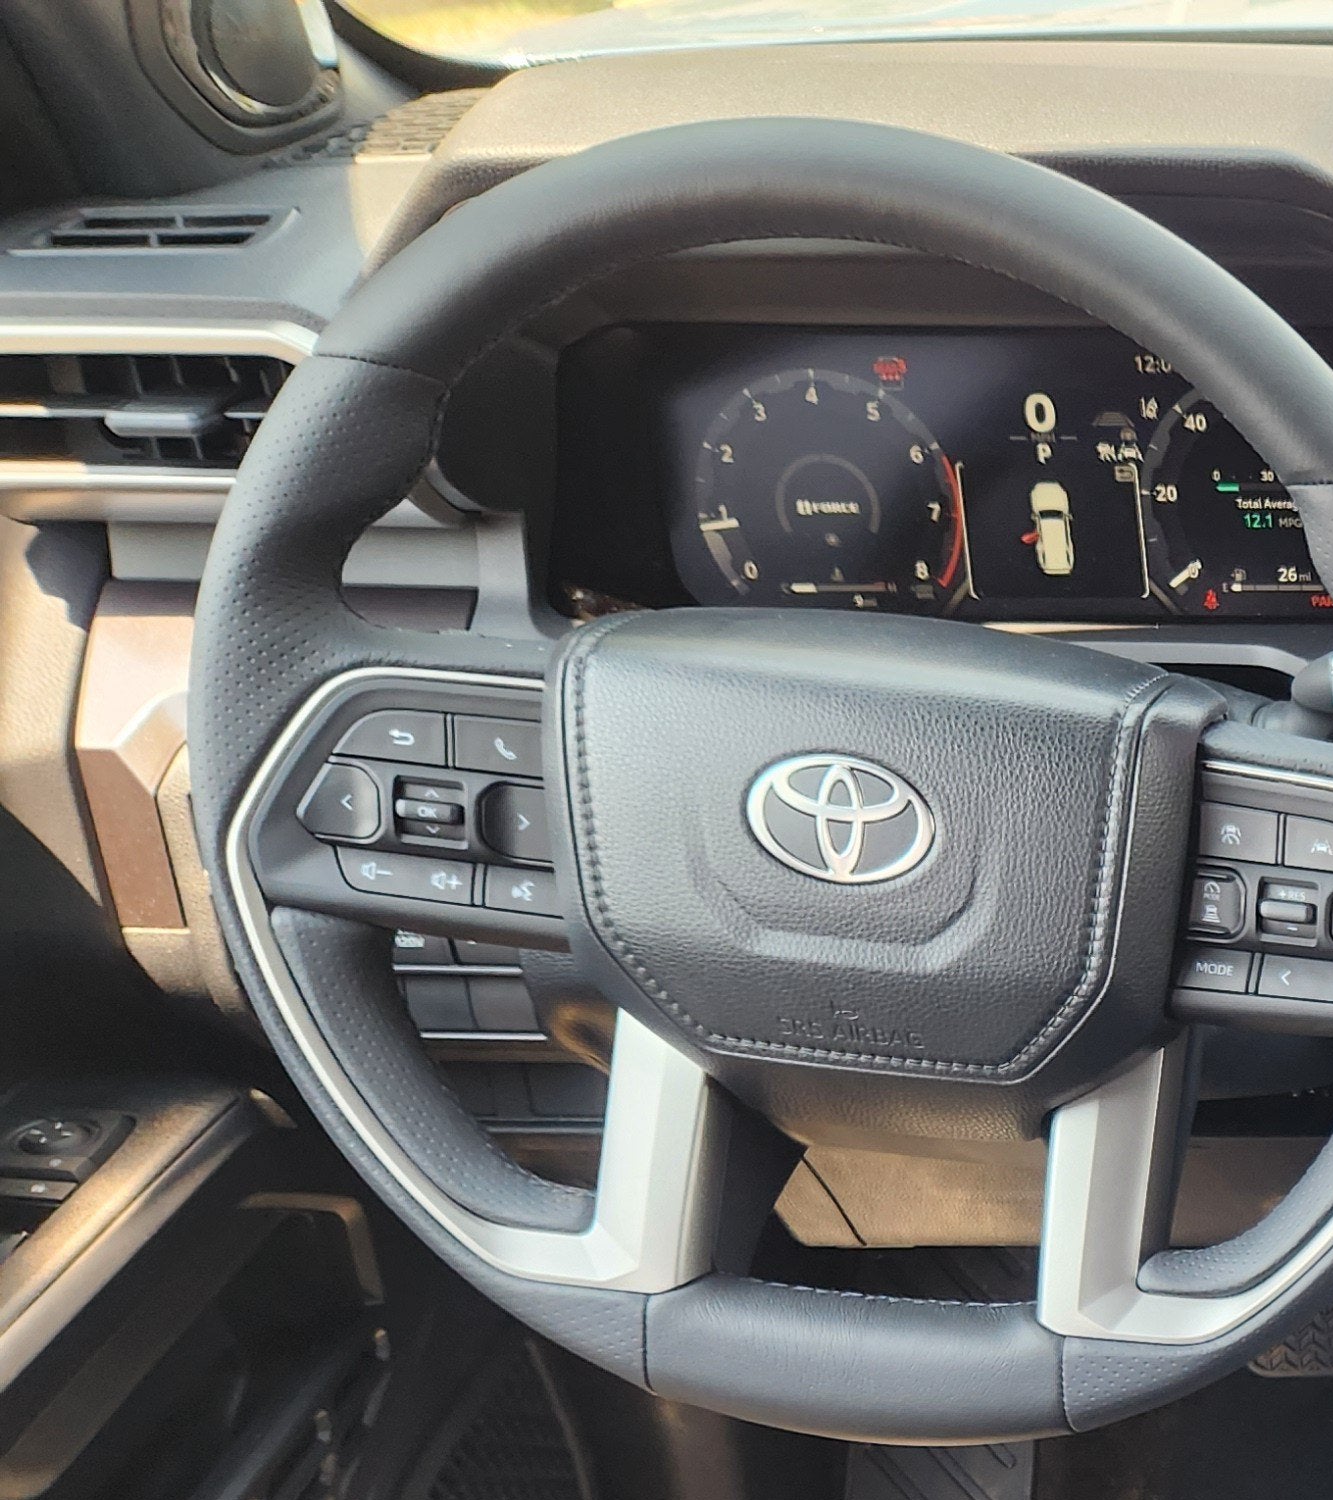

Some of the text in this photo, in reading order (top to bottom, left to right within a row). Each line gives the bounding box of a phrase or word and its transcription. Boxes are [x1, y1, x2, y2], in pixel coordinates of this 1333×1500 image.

[752, 402, 768, 422] 3
[866, 401, 881, 423] 5
[1025, 392, 1057, 433] 0
[1183, 412, 1208, 433] 40
[719, 443, 735, 463] 2
[909, 444, 924, 464] 6
[1036, 441, 1052, 465] P
[1211, 468, 1275, 483] 0 30
[1154, 484, 1178, 503] 20
[927, 501, 942, 523] 7
[1236, 498, 1262, 511] Total
[1243, 513, 1274, 529] 12.1
[742, 560, 760, 581] 0
[914, 560, 929, 580] 8
[1276, 566, 1312, 583] 26 mi
[1195, 962, 1234, 977] MODE
[832, 1023, 926, 1049] AIRBAG
